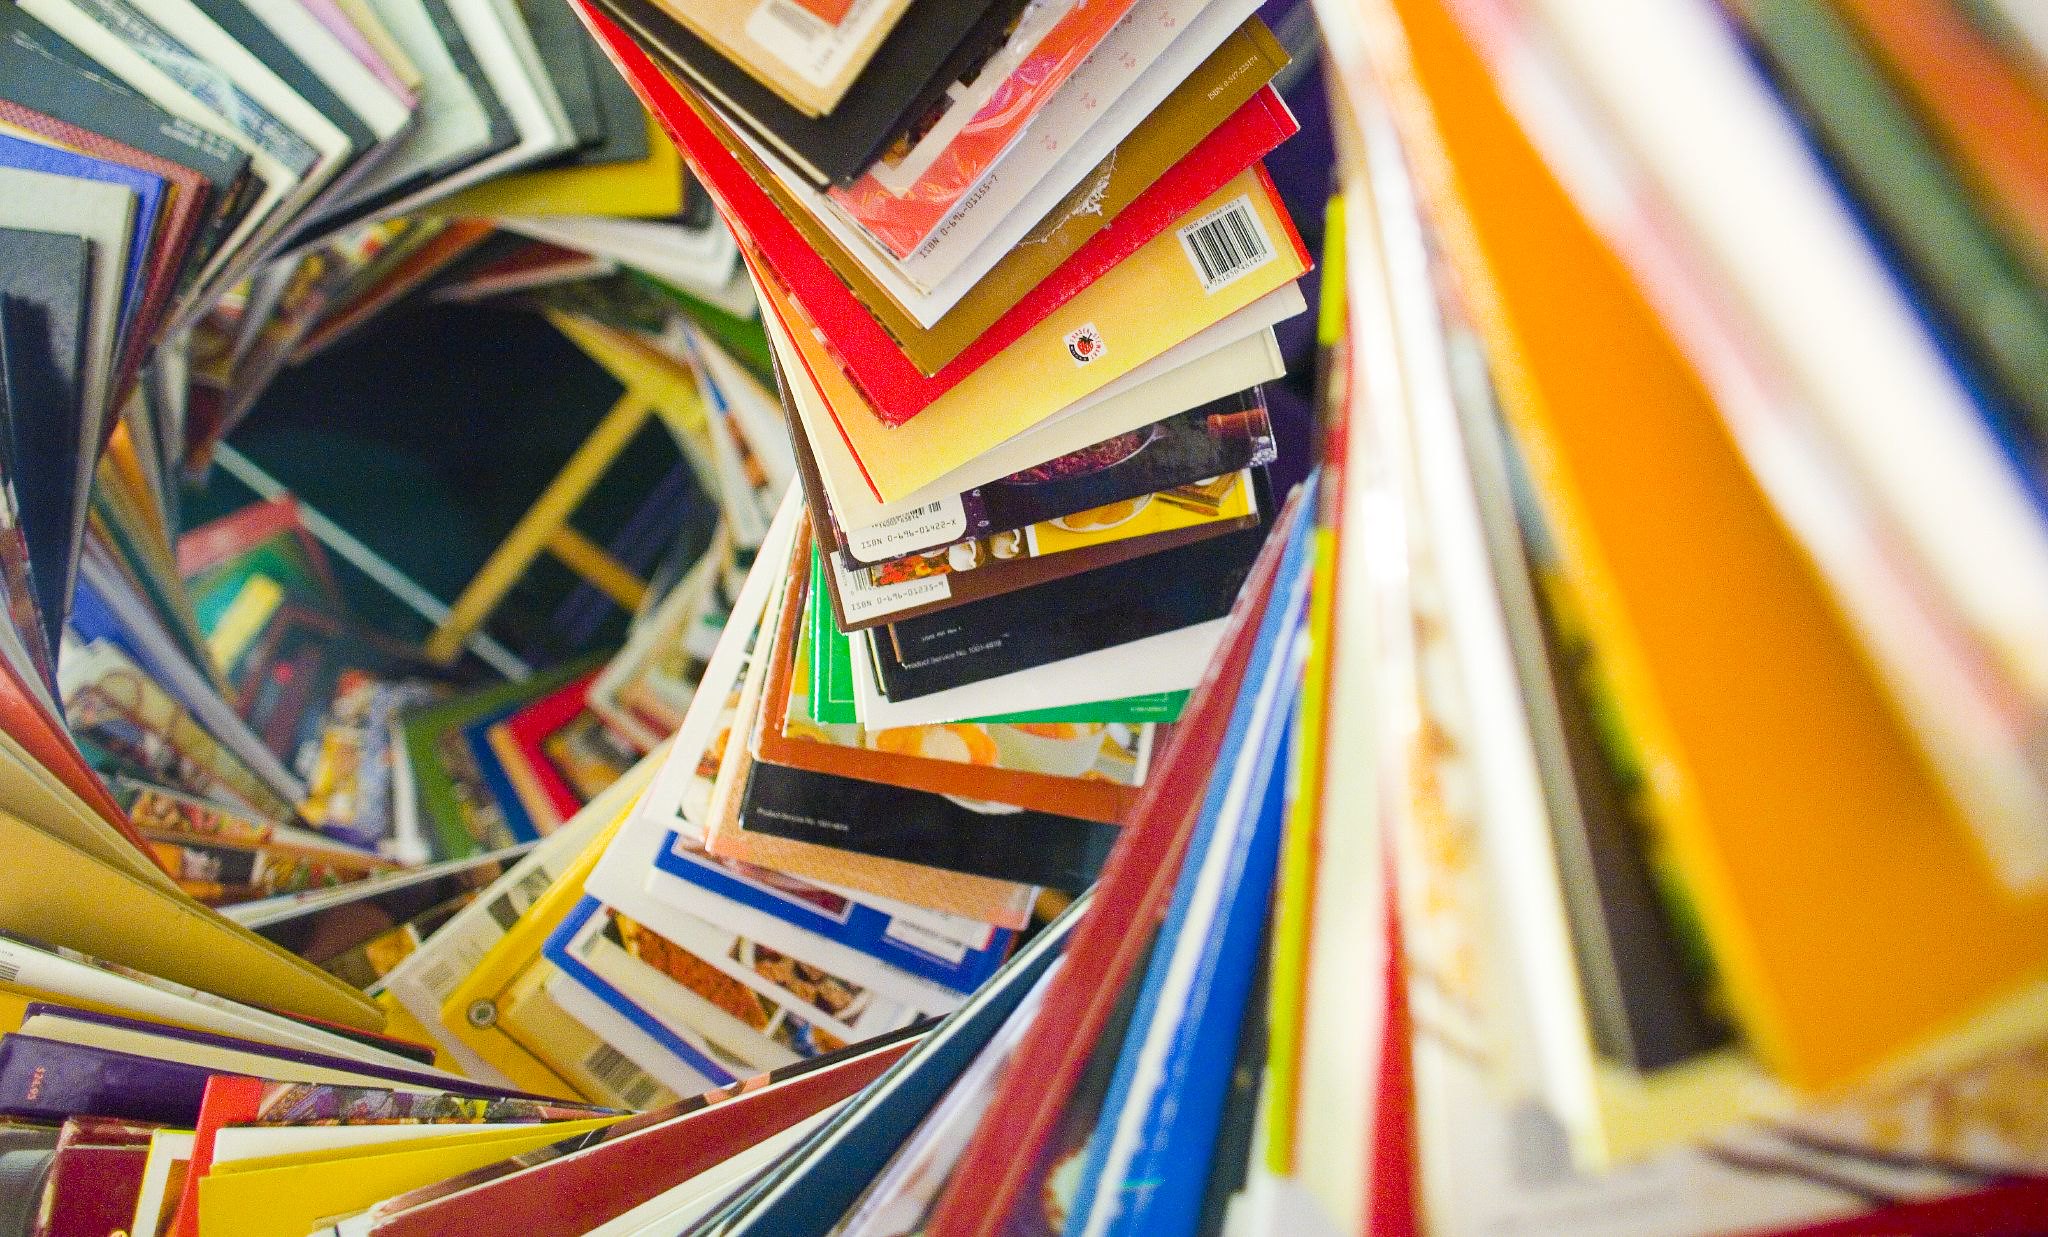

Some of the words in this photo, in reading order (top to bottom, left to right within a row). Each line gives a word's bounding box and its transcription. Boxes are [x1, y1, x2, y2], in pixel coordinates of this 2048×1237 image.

[919, 236, 940, 258] ISBN
[861, 537, 883, 550] ISBN
[851, 600, 872, 611] ISBN
